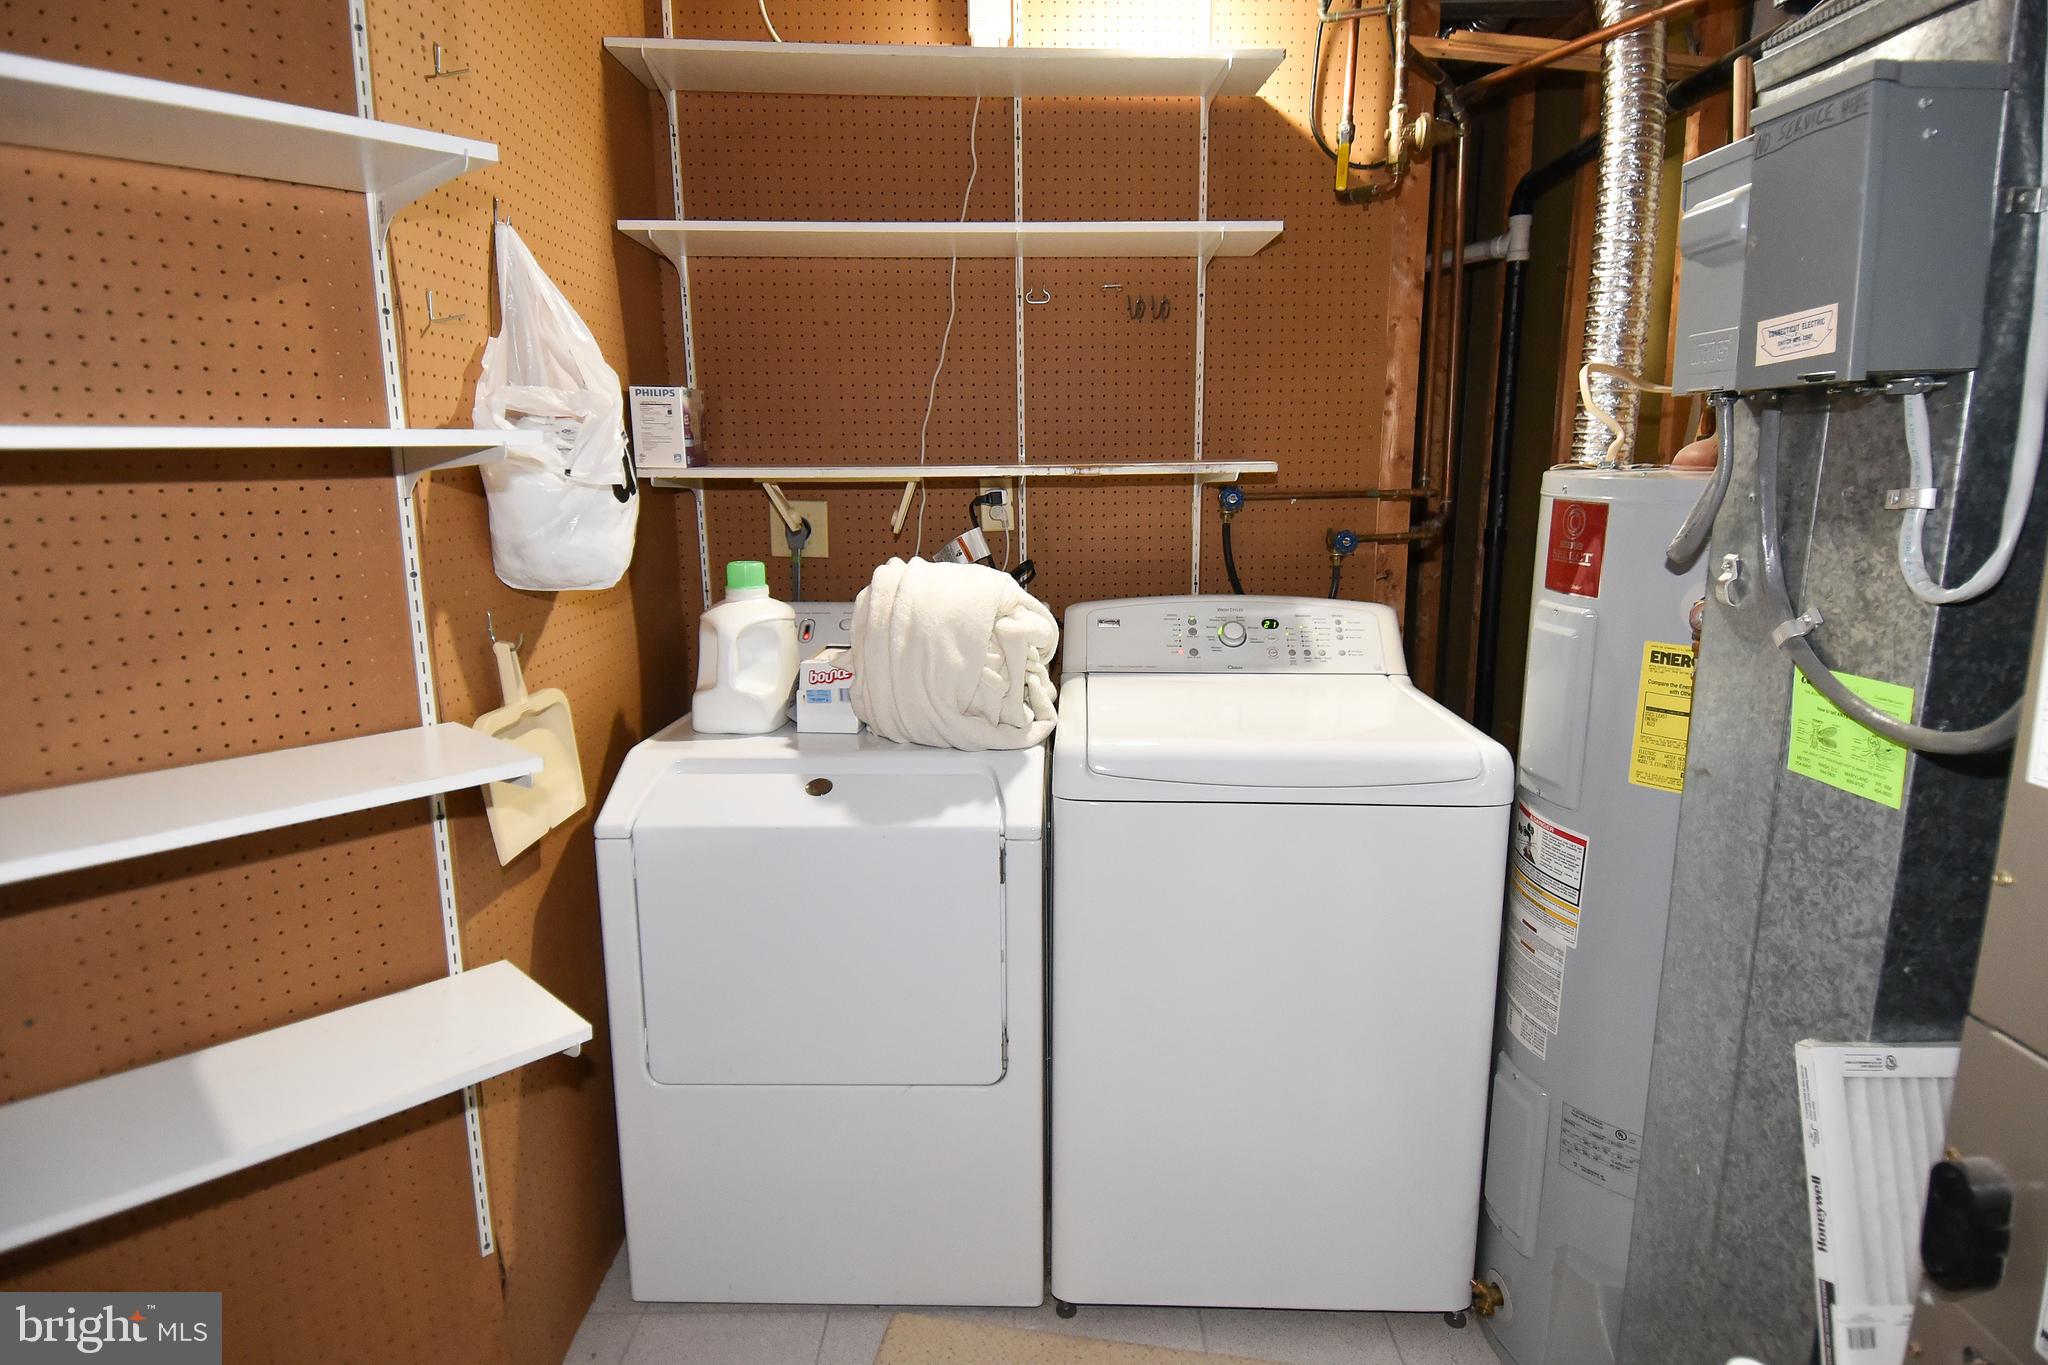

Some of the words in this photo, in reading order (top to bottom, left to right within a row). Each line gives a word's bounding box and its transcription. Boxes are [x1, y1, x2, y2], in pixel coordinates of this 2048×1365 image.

[1777, 103, 1834, 141] SERVICE
[1801, 317, 1826, 331] ELECTRIC
[635, 388, 676, 397] PHILIPS
[1647, 678, 1669, 688] Compare
[1811, 1175, 1828, 1253] Honeywell
